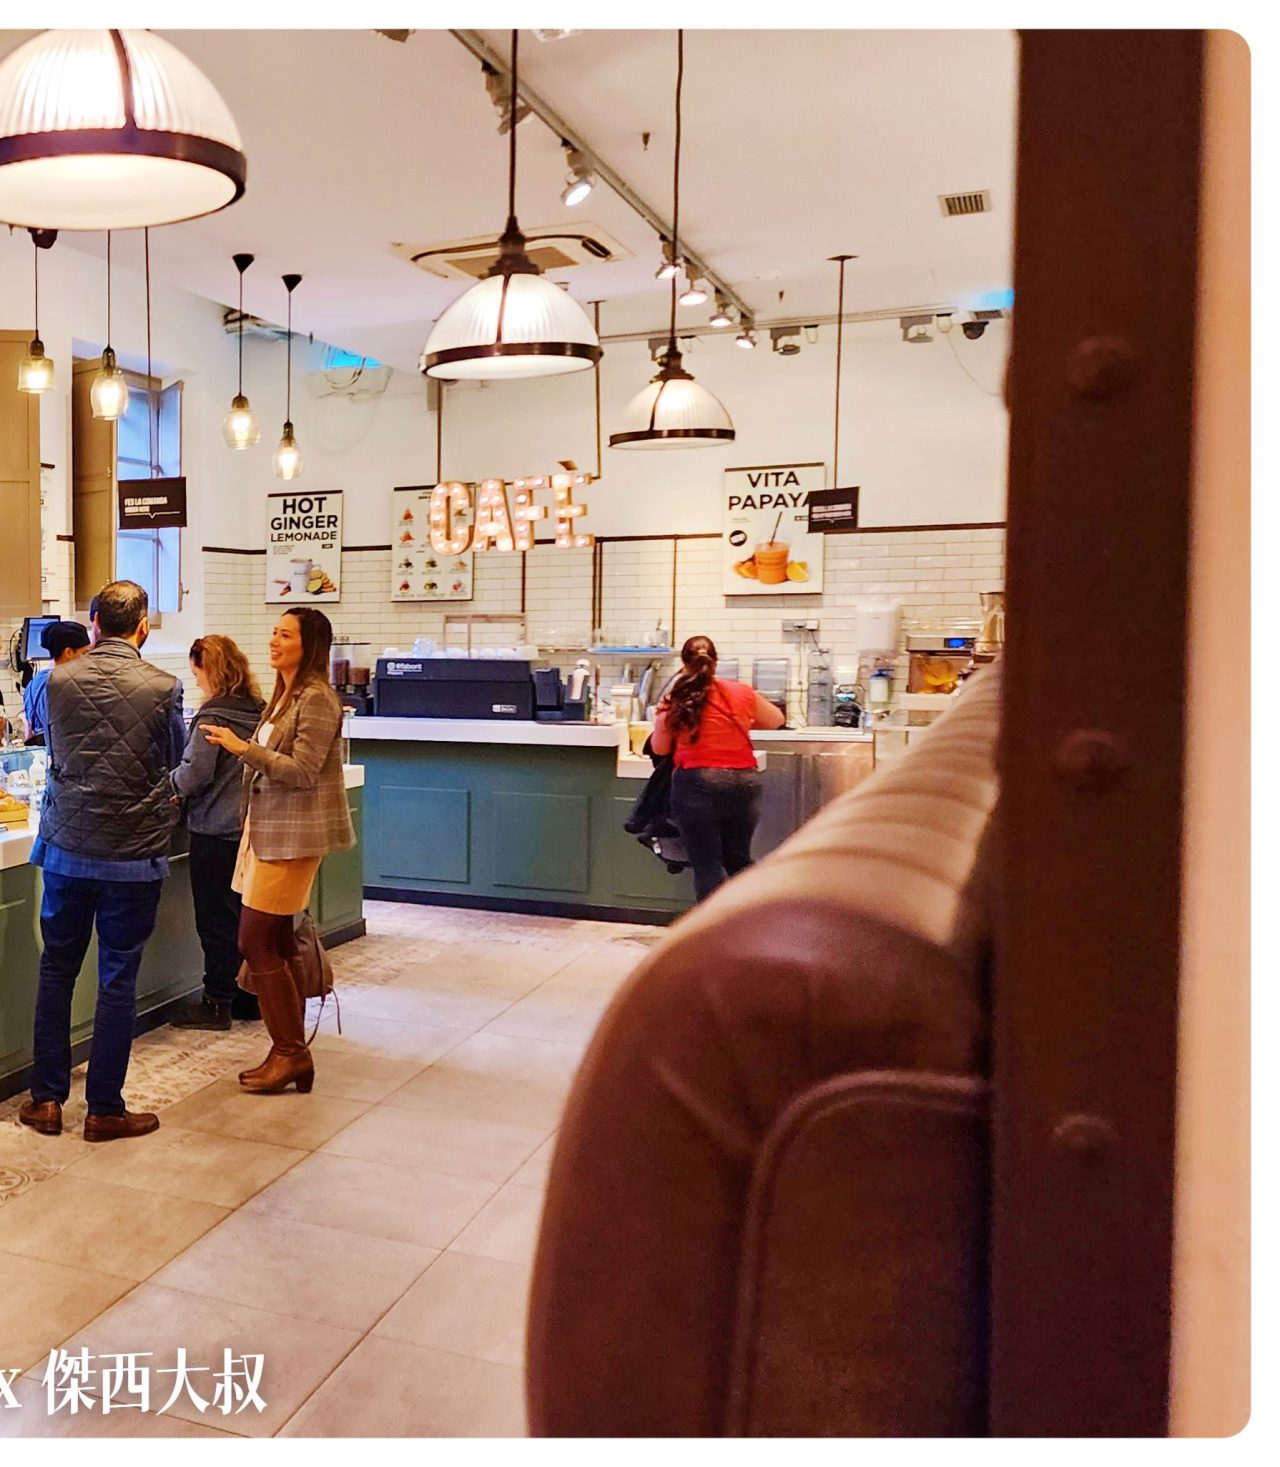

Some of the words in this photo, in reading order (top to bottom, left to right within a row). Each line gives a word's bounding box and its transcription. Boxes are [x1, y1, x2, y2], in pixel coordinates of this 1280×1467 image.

[747, 471, 800, 488] VITA
[282, 497, 327, 515] HOT
[271, 515, 338, 531] GINGER
[271, 531, 337, 542] LEMONADE
